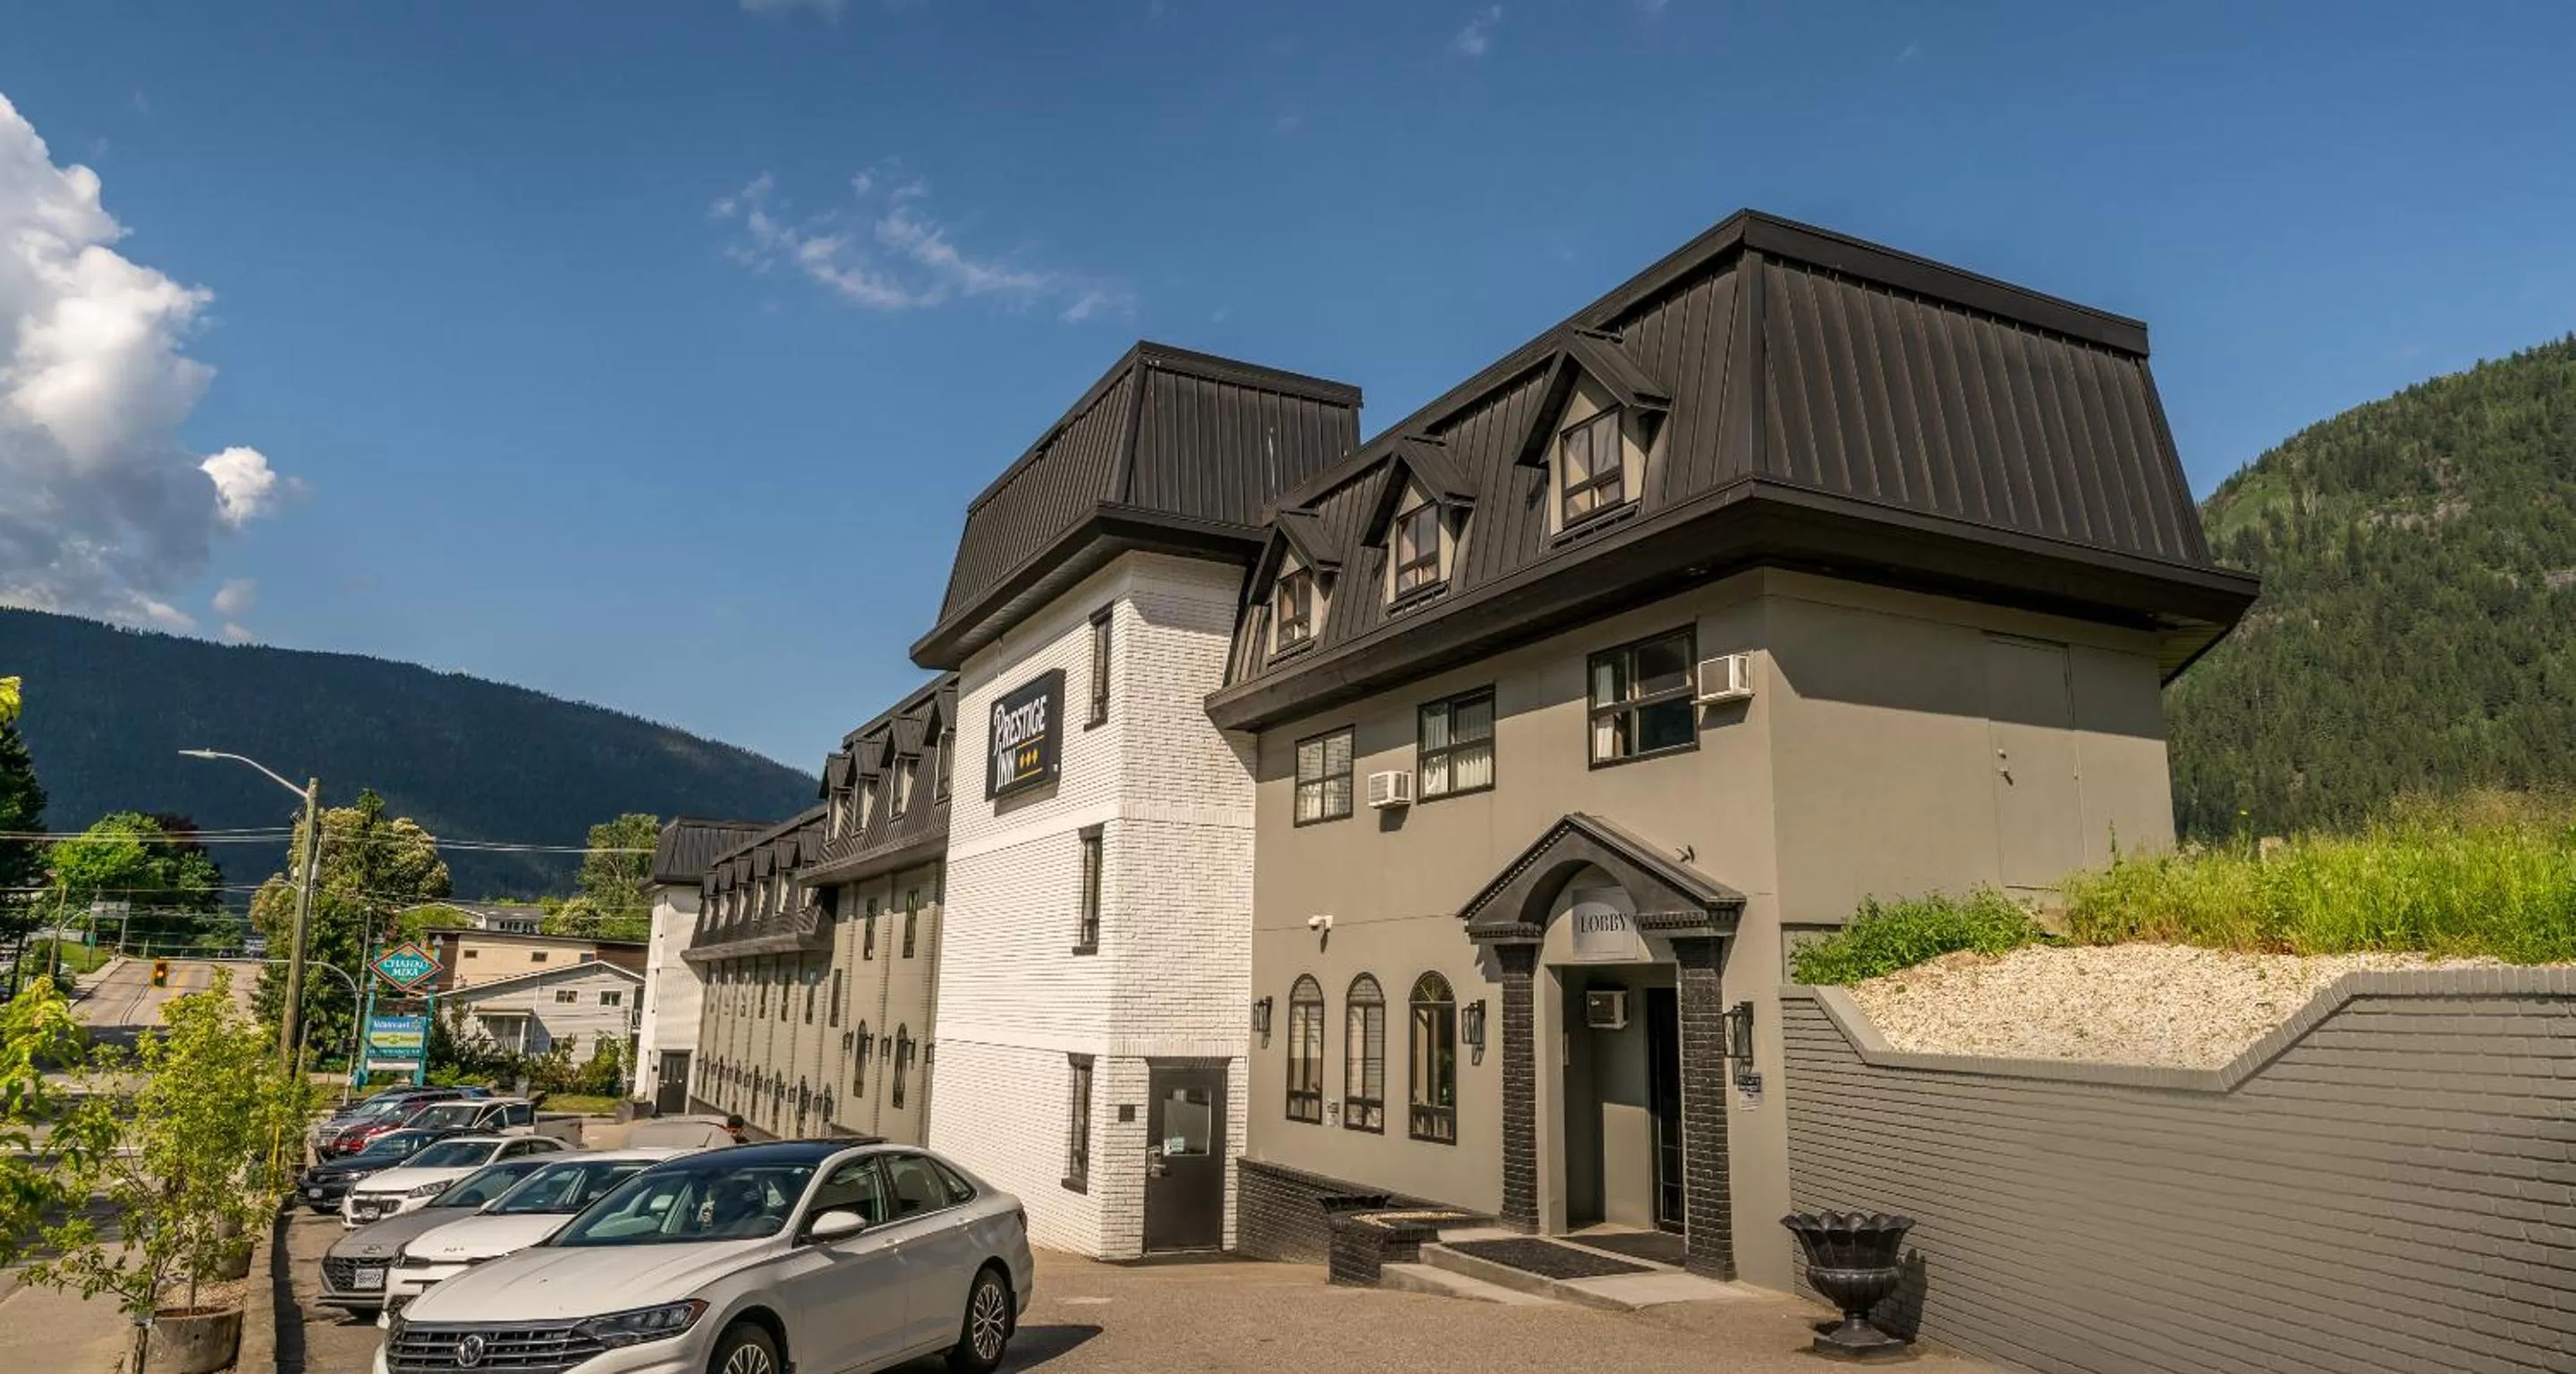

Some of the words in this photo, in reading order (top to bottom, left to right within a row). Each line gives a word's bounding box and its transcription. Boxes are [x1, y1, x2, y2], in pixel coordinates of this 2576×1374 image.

[993, 695, 1047, 757] PRESTIGE
[995, 742, 1016, 793] INN
[1580, 912, 1628, 933] LOBBY
